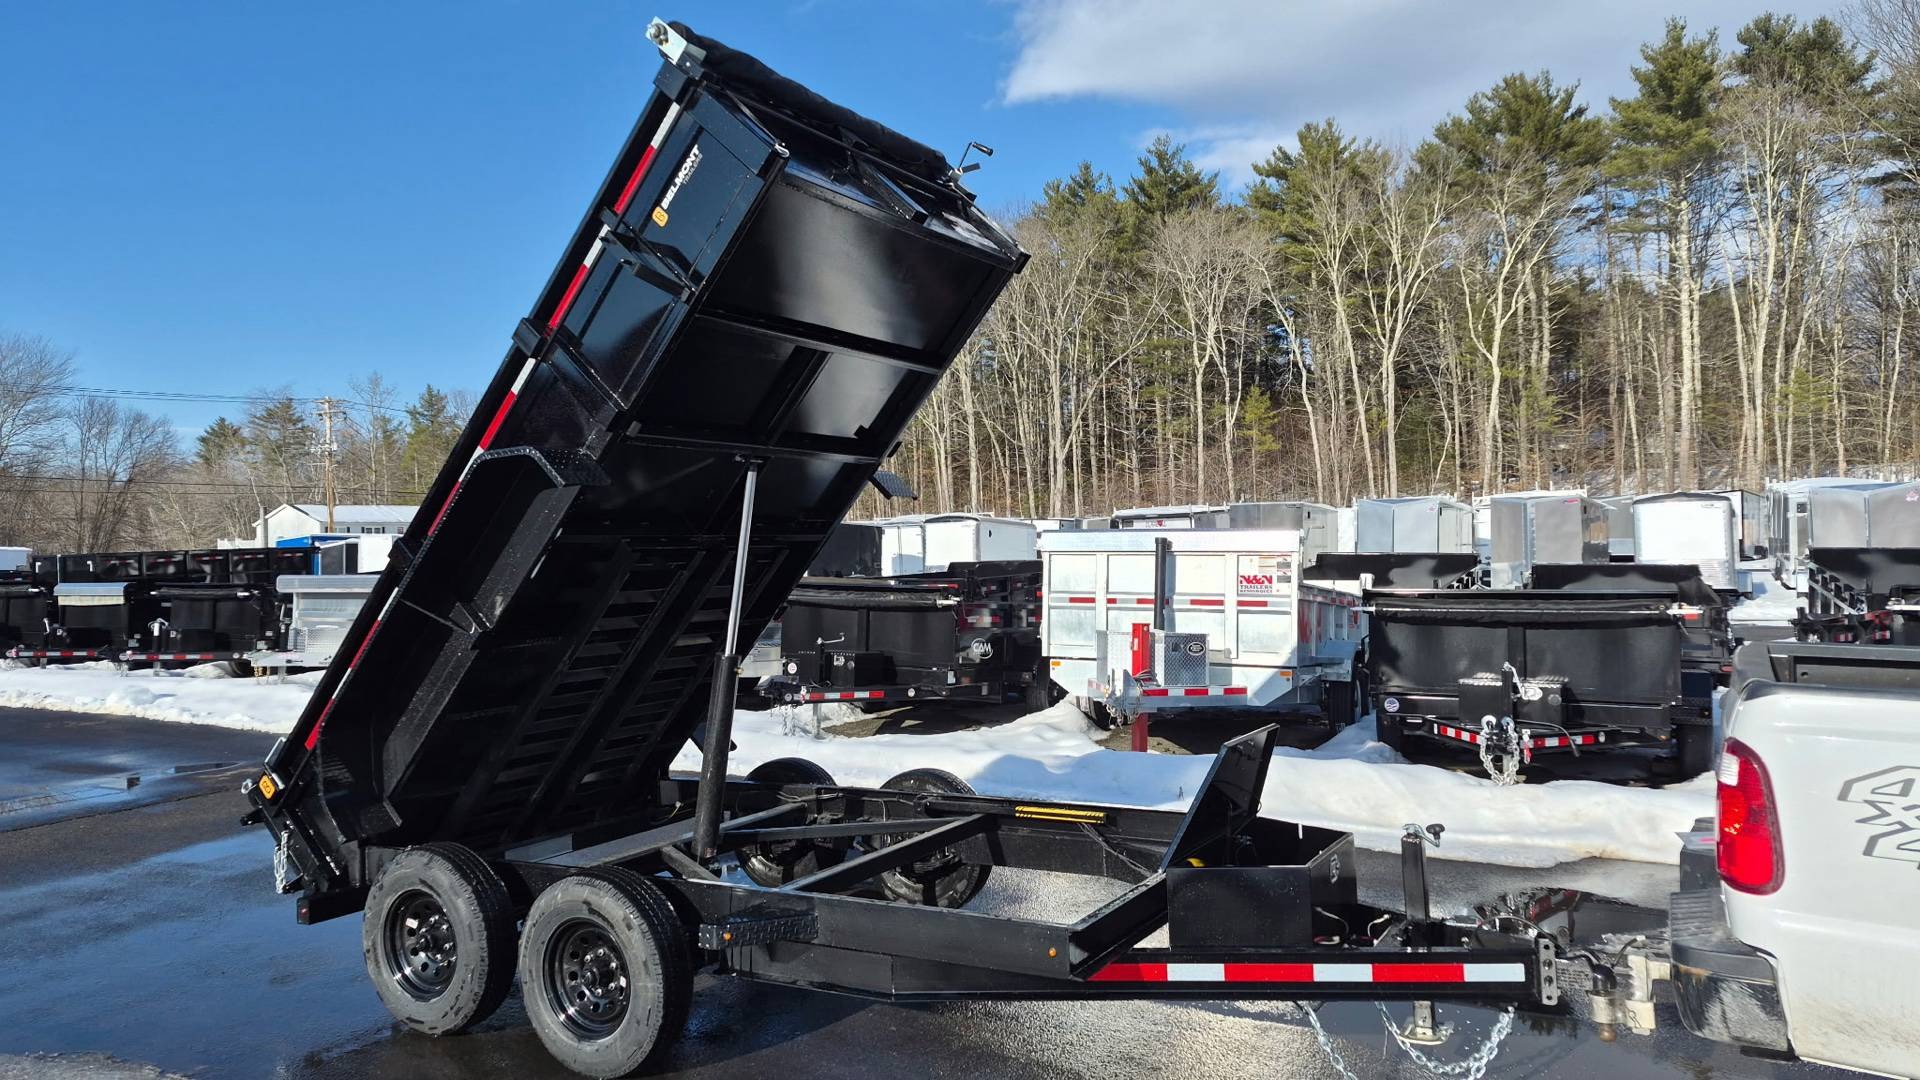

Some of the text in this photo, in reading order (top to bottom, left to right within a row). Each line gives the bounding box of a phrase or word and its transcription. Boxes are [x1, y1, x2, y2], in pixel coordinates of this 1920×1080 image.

[661, 144, 700, 210] BELMONT
[683, 153, 703, 185] TRAILERS
[1240, 575, 1272, 584] N&N
[973, 642, 992, 653] CAM
